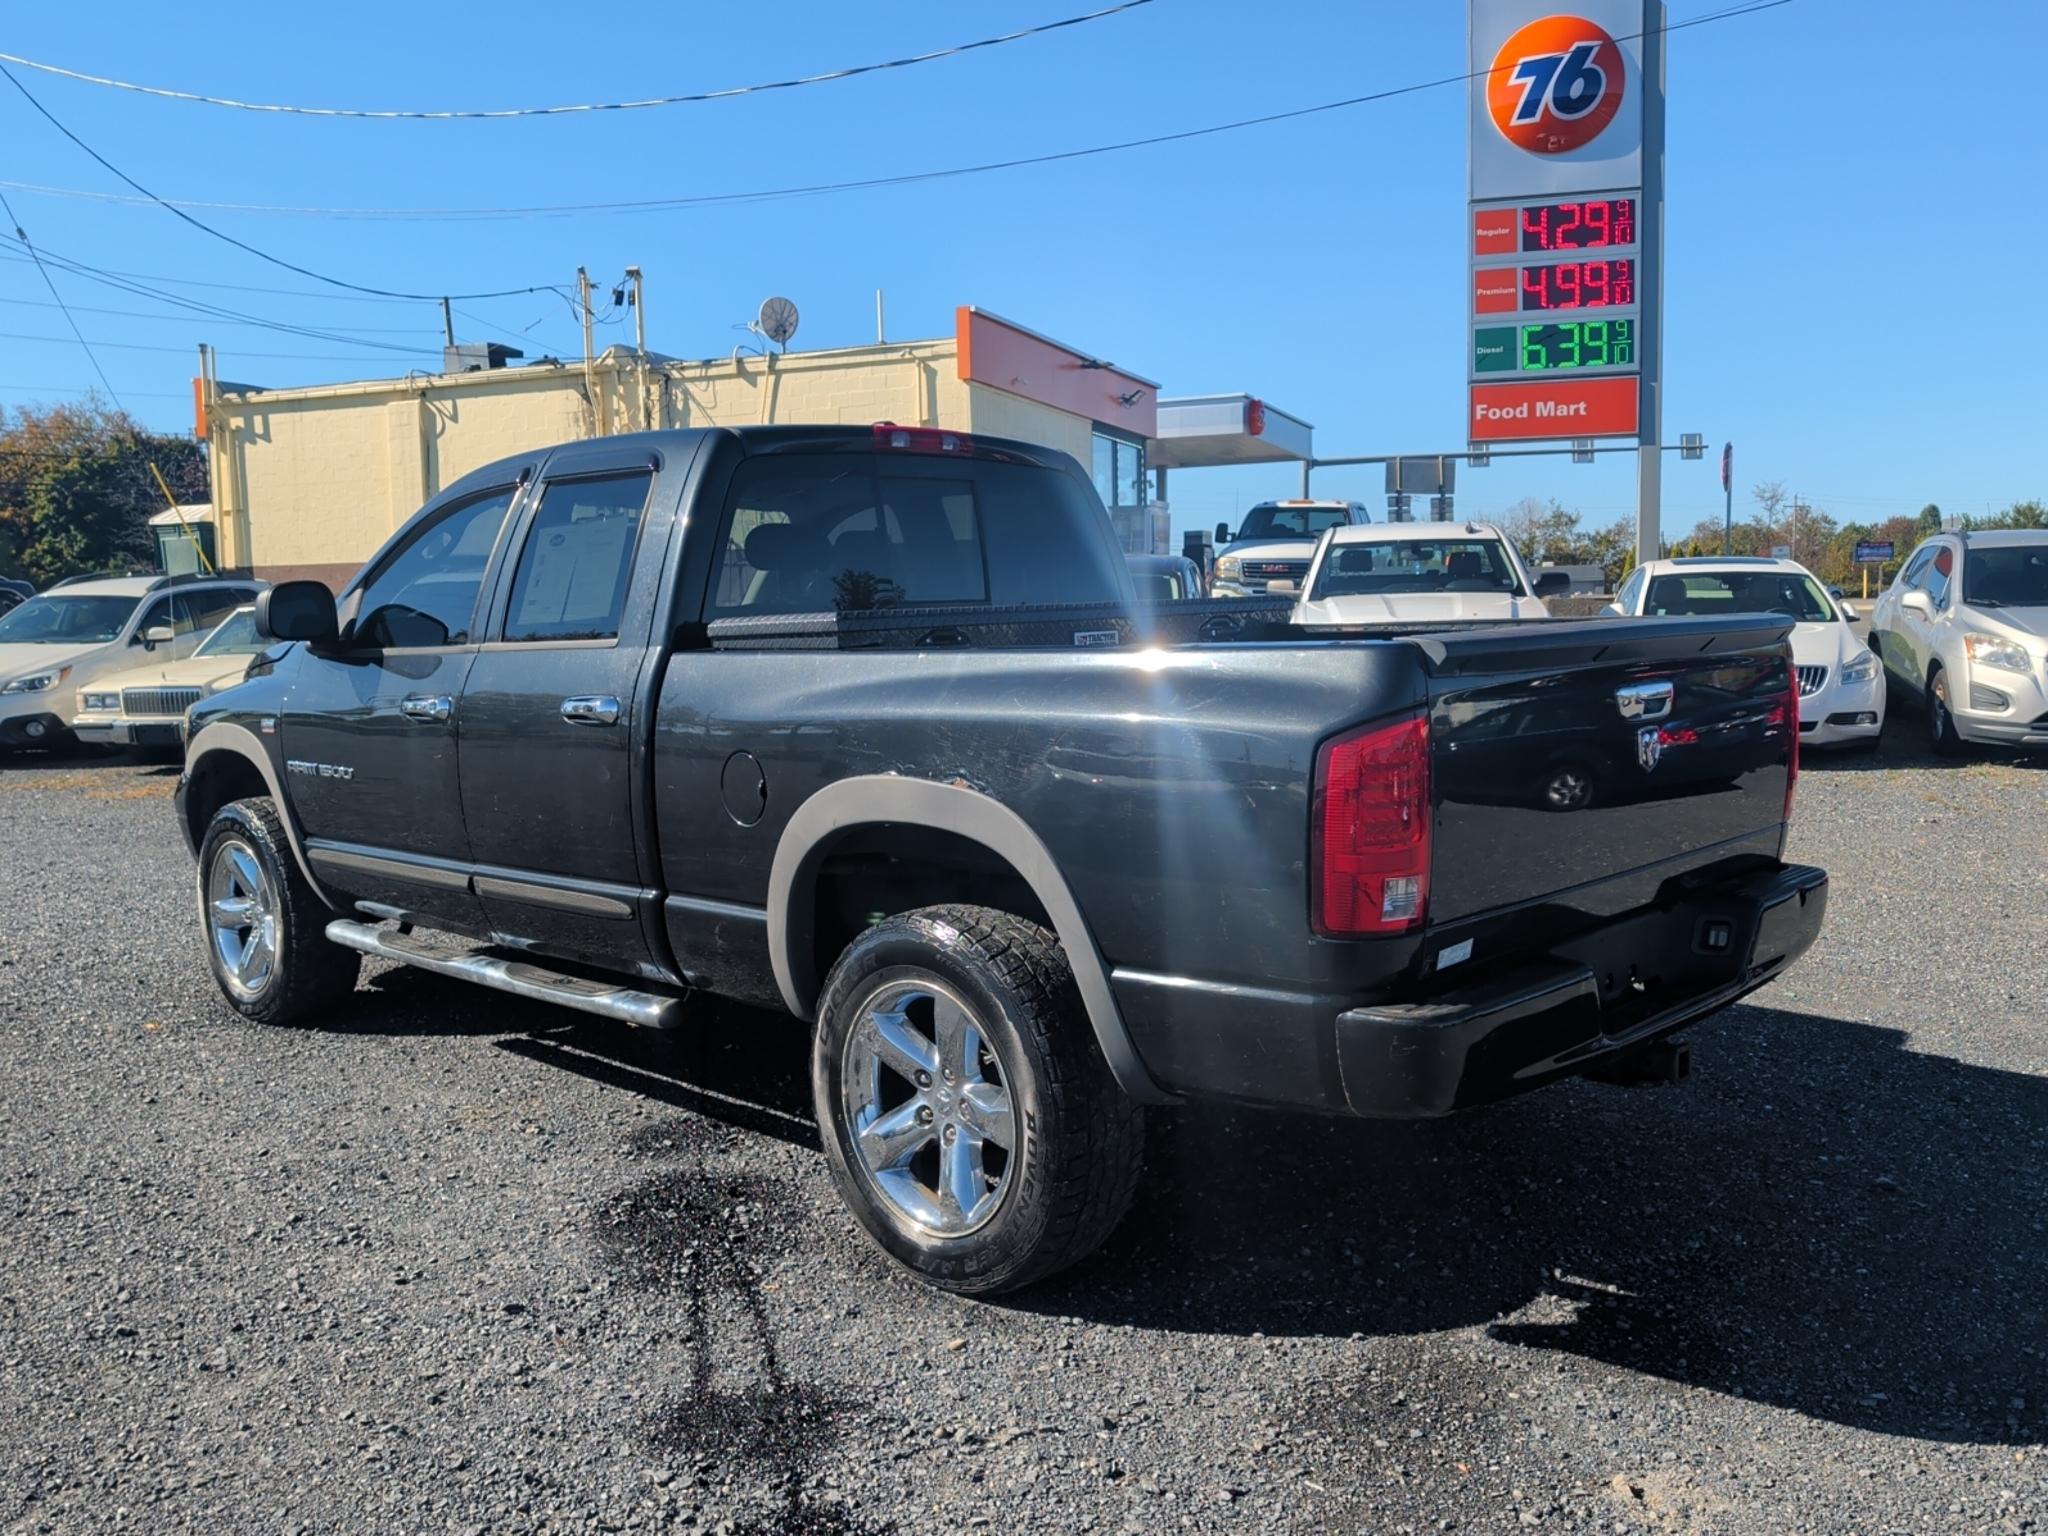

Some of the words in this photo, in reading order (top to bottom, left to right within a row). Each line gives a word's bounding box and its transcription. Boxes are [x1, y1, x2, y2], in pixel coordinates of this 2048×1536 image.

[1507, 41, 1606, 127] 76
[1477, 227, 1510, 238] Regular
[1522, 201, 1609, 249] 4.29
[1477, 286, 1516, 297] Premium
[1522, 260, 1609, 309] 4.99
[1476, 345, 1504, 355] Diesel
[1522, 320, 1608, 370] 6.39
[1475, 402, 1528, 420] Food
[1535, 401, 1588, 417] Mart
[1262, 563, 1289, 573] GMC
[287, 760, 317, 776] RAM
[319, 763, 354, 780] 1500
